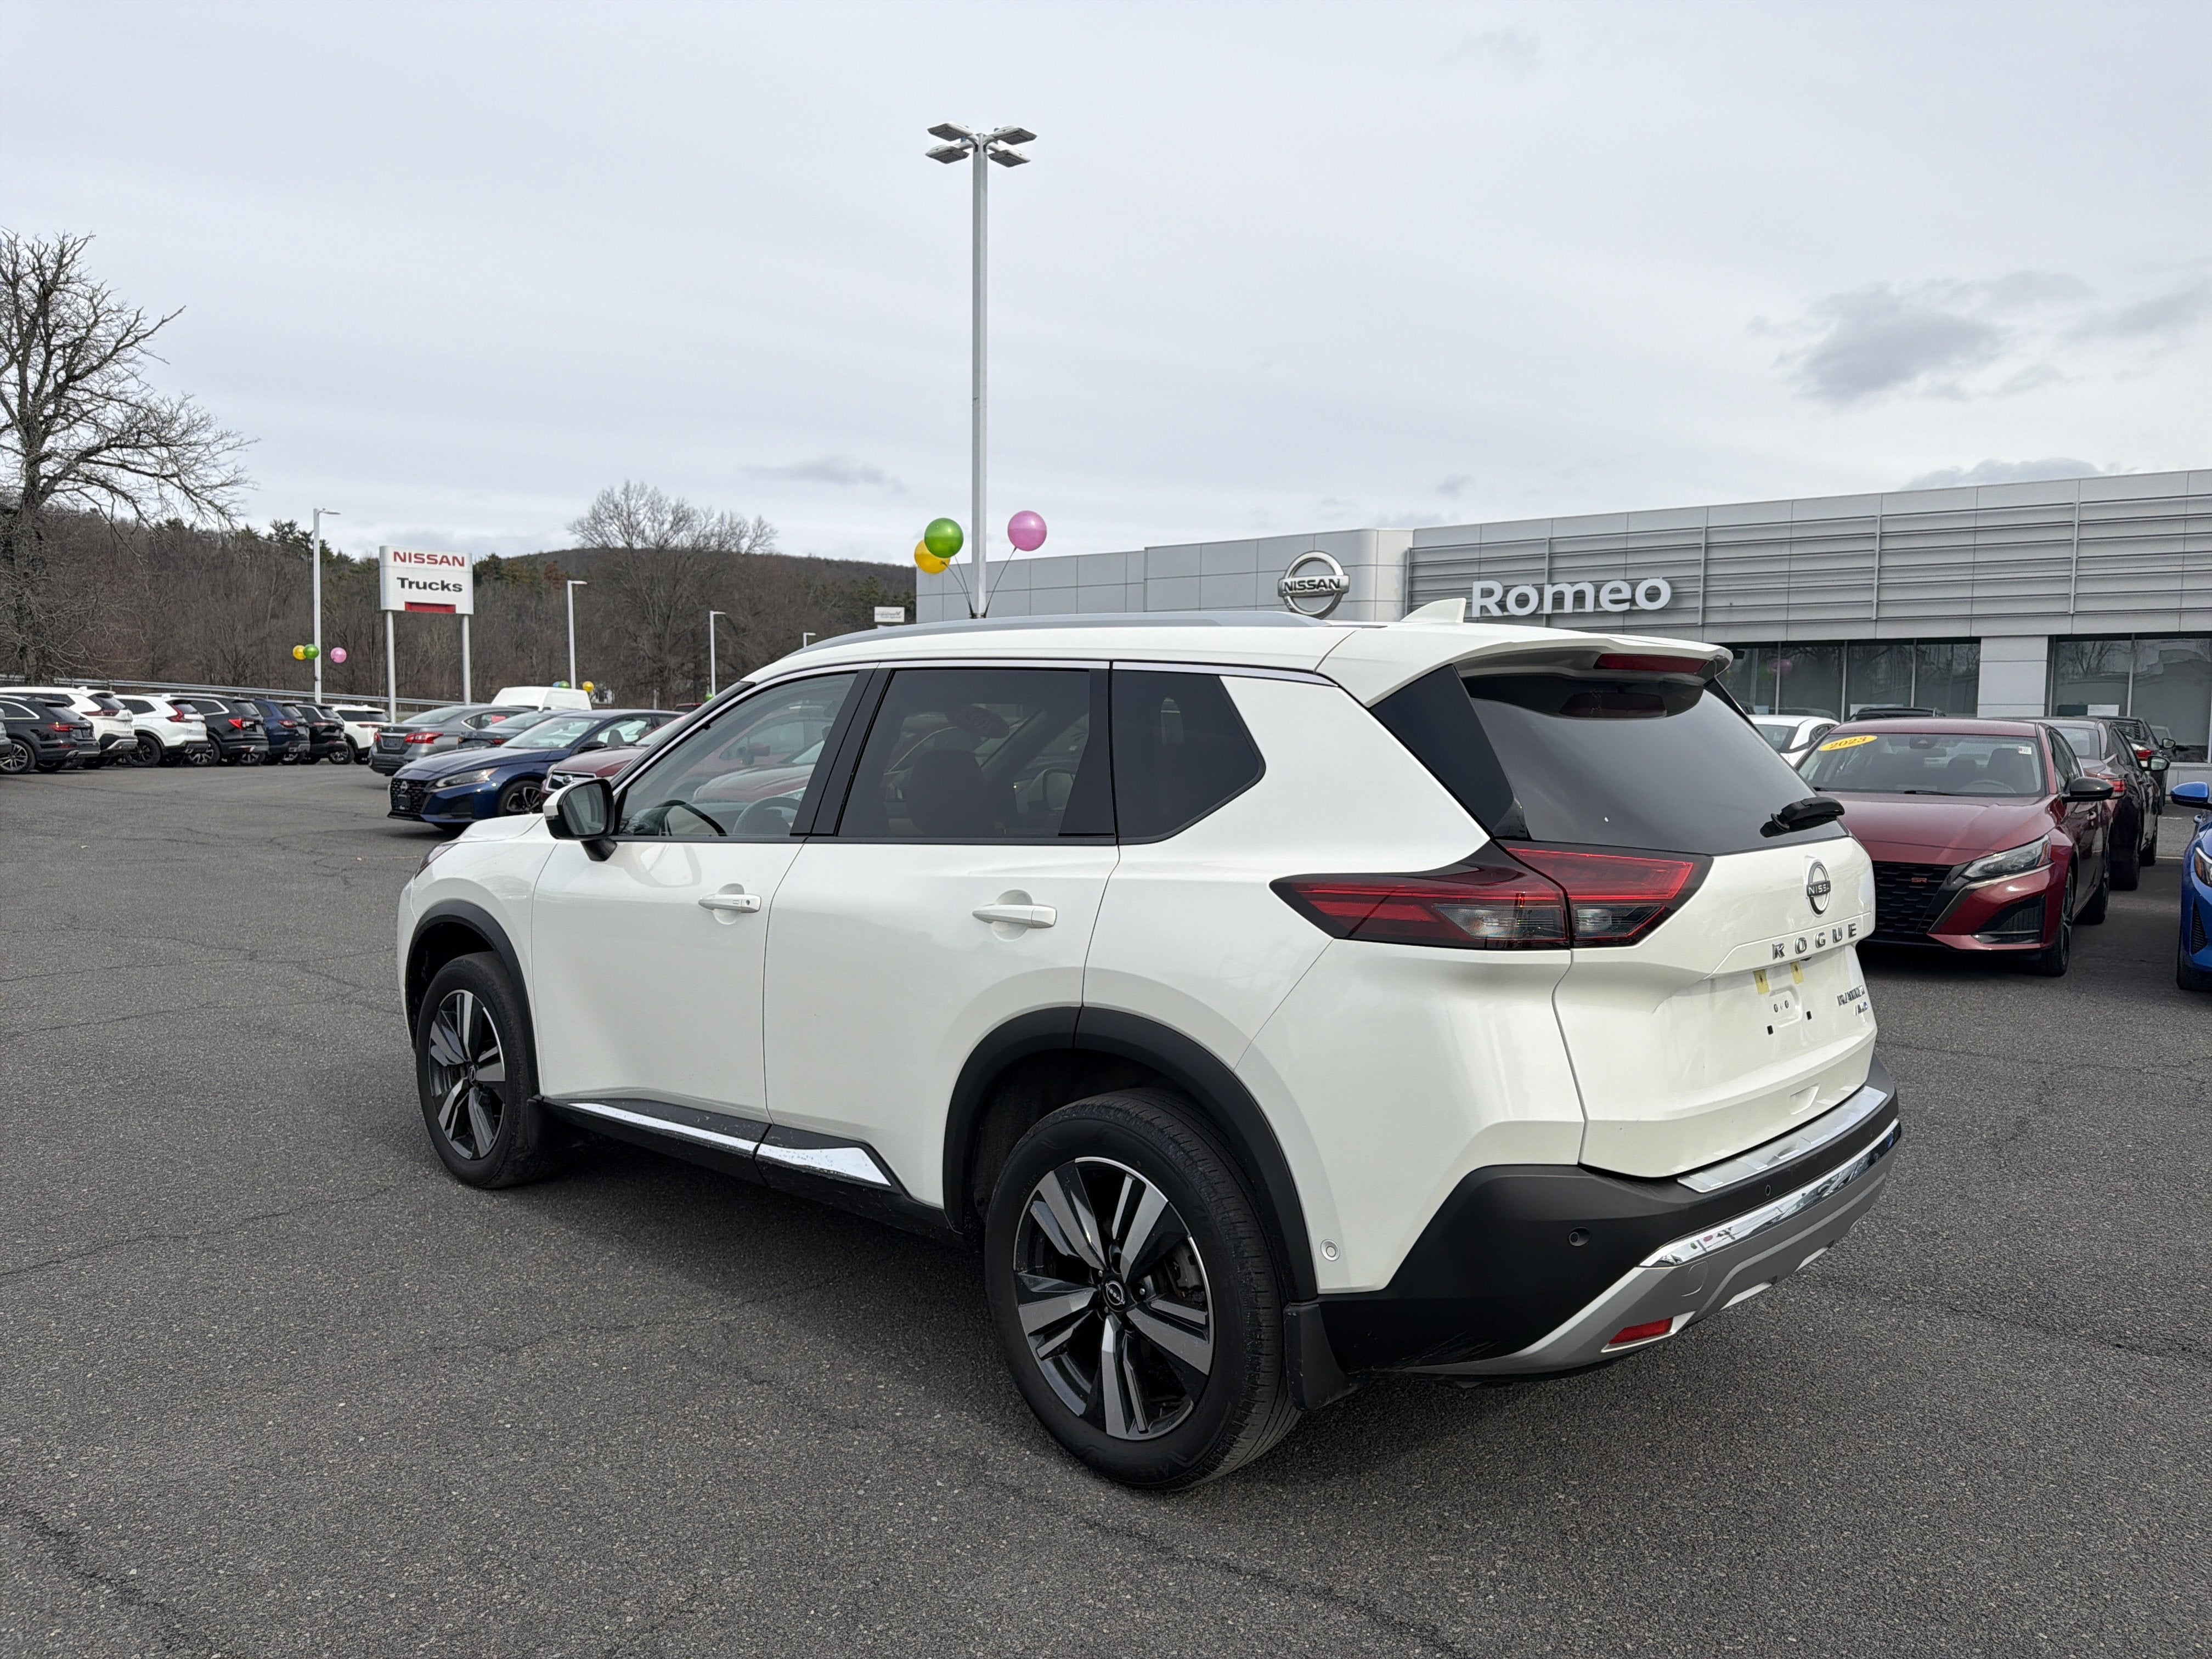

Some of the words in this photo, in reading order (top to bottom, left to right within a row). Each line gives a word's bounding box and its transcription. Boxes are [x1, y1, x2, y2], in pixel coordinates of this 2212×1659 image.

[393, 551, 465, 567] NISSAN
[397, 577, 462, 592] Trucks
[1284, 578, 1340, 591] NISSAN
[1471, 577, 1672, 618] Romeo
[1829, 737, 1867, 749] 2023
[1808, 883, 1830, 895] NISS
[1772, 923, 1857, 960] ROGUE
